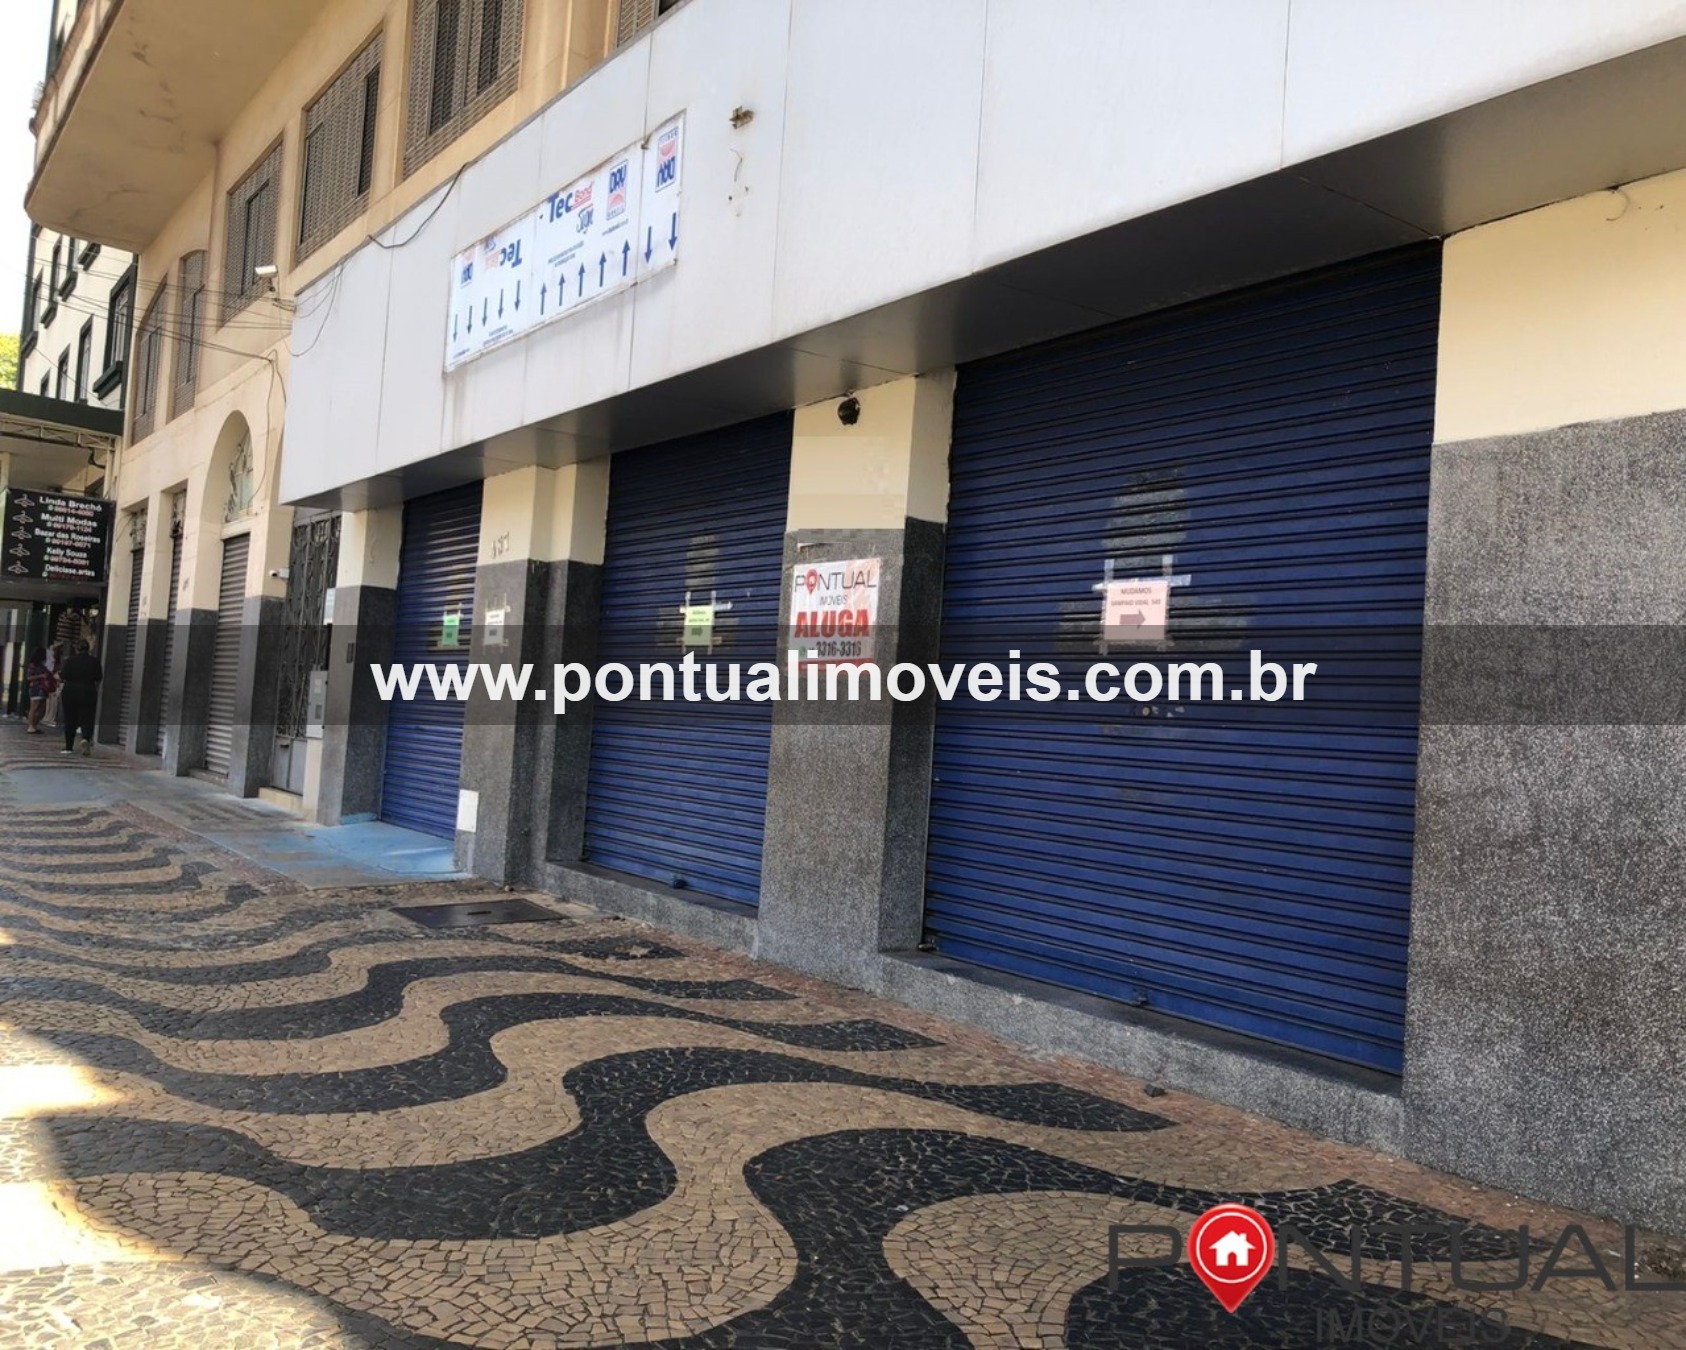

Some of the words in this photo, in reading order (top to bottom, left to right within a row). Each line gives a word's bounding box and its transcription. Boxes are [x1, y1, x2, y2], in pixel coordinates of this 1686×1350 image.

[548, 191, 573, 223] Tec
[40, 496, 66, 507] Linda
[41, 513, 65, 523] Multi
[67, 516, 97, 528] Modas
[794, 569, 877, 594] PONTUAL
[1120, 587, 1152, 595] MUDAMOS
[794, 609, 870, 638] ALUGA
